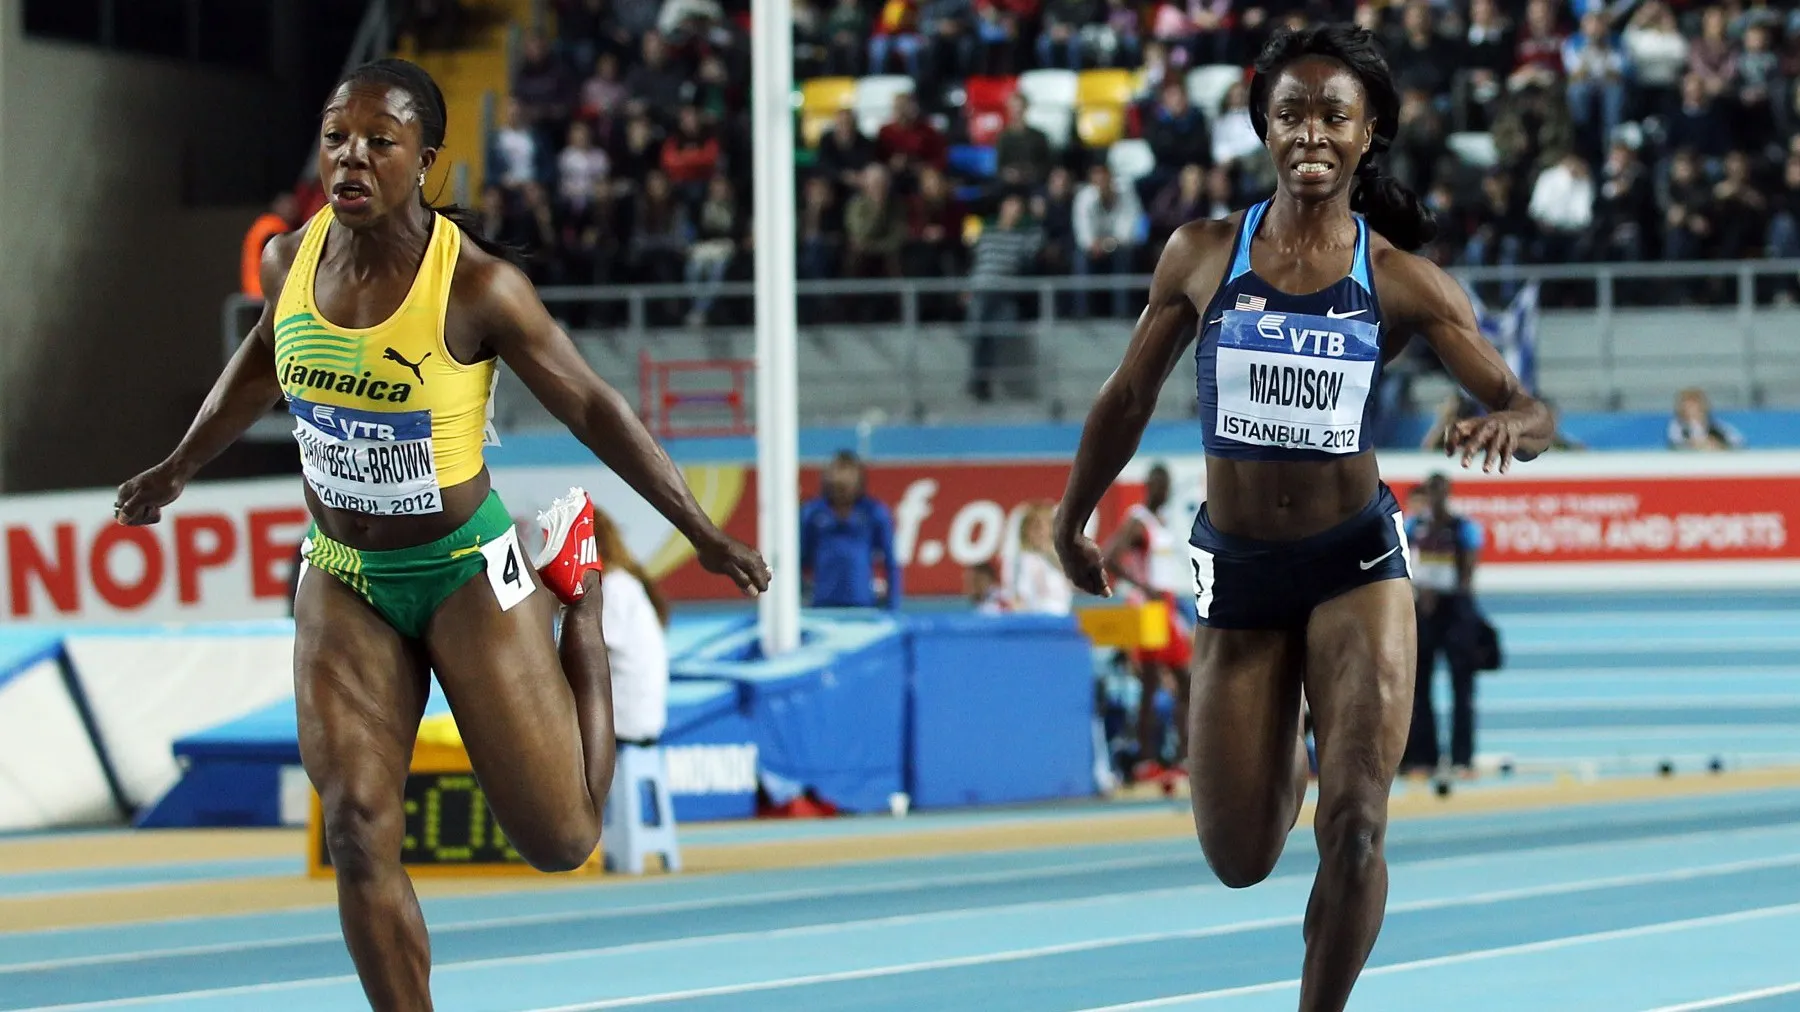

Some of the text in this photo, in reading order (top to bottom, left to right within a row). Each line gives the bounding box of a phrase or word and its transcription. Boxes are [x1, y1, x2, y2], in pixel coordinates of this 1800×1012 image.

[1290, 328, 1345, 357] VTB
[281, 356, 412, 403] jamaica
[1250, 363, 1344, 411] MADISON
[340, 418, 396, 441] VTB
[1223, 415, 1355, 448] ISTANBUL 2012
[309, 478, 436, 515] TANBUL 2012
[1674, 511, 1786, 550] SPORTS
[5, 508, 308, 619] NOPE
[503, 543, 522, 590] 4
